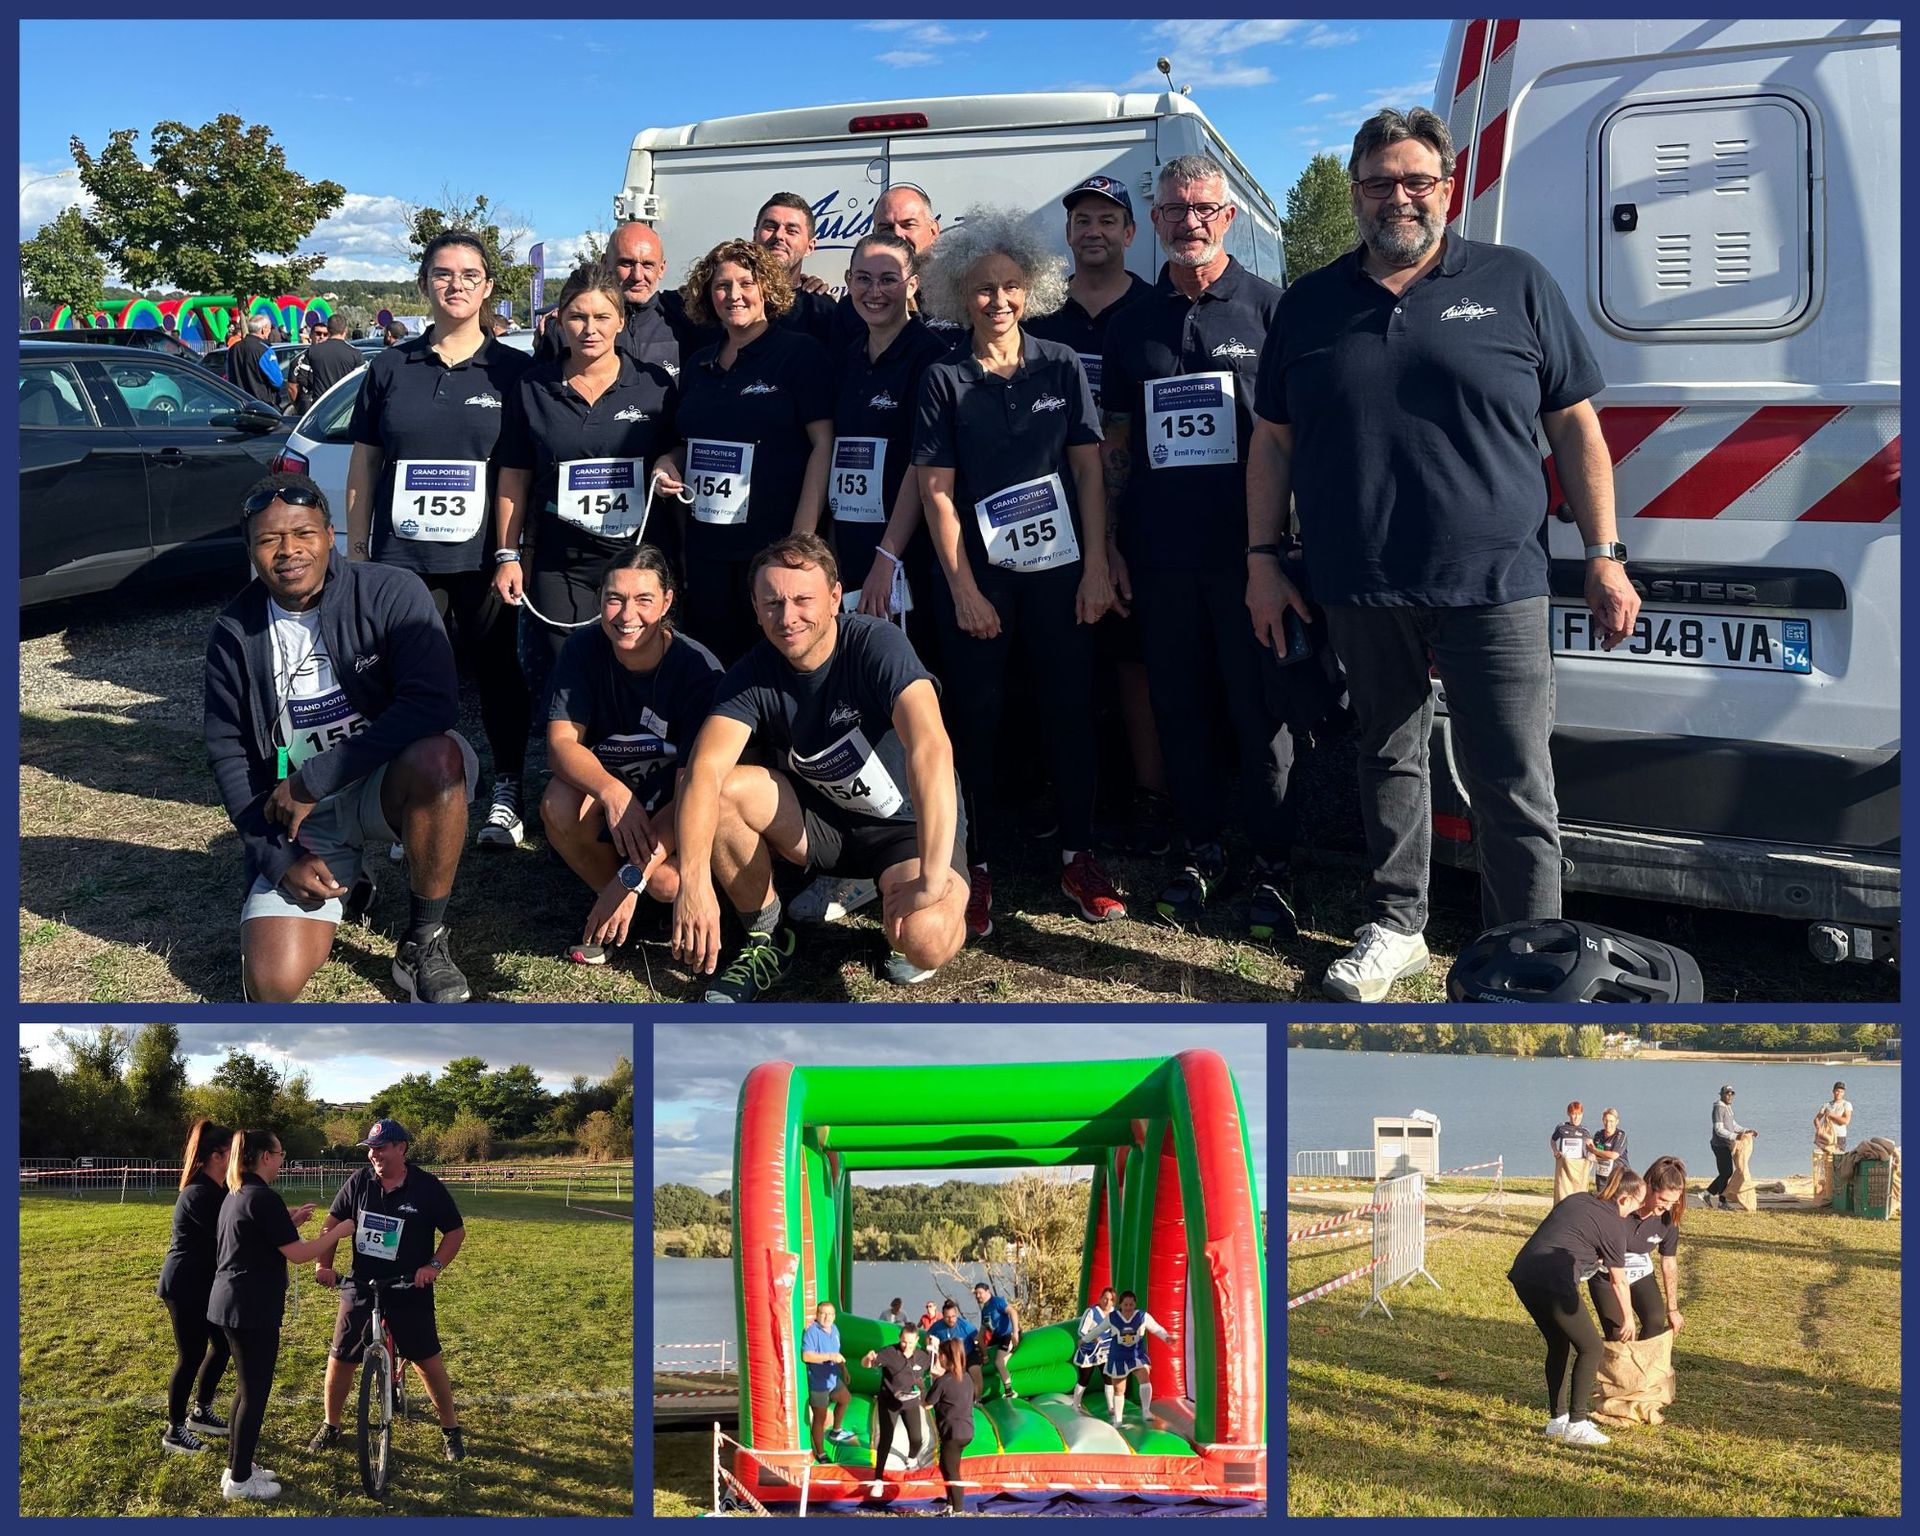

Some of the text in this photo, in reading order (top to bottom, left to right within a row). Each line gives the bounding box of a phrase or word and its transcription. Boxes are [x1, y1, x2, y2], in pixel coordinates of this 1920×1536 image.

[1158, 383, 1215, 395] GRAND POITIERS
[1161, 413, 1216, 439] 153
[711, 449, 737, 458] POITIERS
[1174, 449, 1190, 457] Emil
[1190, 447, 1206, 457] Frey
[1206, 447, 1230, 455] France
[575, 466, 629, 475] GRAND POITIERS
[693, 475, 732, 499] 154
[836, 473, 868, 496] 153
[413, 495, 467, 517] 153
[577, 493, 630, 515] 154
[991, 487, 1049, 511] GRAND POITIERS
[439, 526, 455, 534] Frey
[1004, 517, 1057, 552] 155
[1023, 548, 1072, 567] Emil Frey France
[1630, 579, 1757, 601] ASTER
[1786, 629, 1805, 639] Est
[1784, 646, 1808, 667] 54
[293, 703, 321, 713] GRAND
[598, 744, 657, 753] GRAND POITIERS
[815, 749, 850, 770] POITIERS
[817, 776, 872, 801] 154
[1586, 936, 1598, 951] ST
[365, 1231, 385, 1245] 15
[1625, 1269, 1645, 1280] 53
